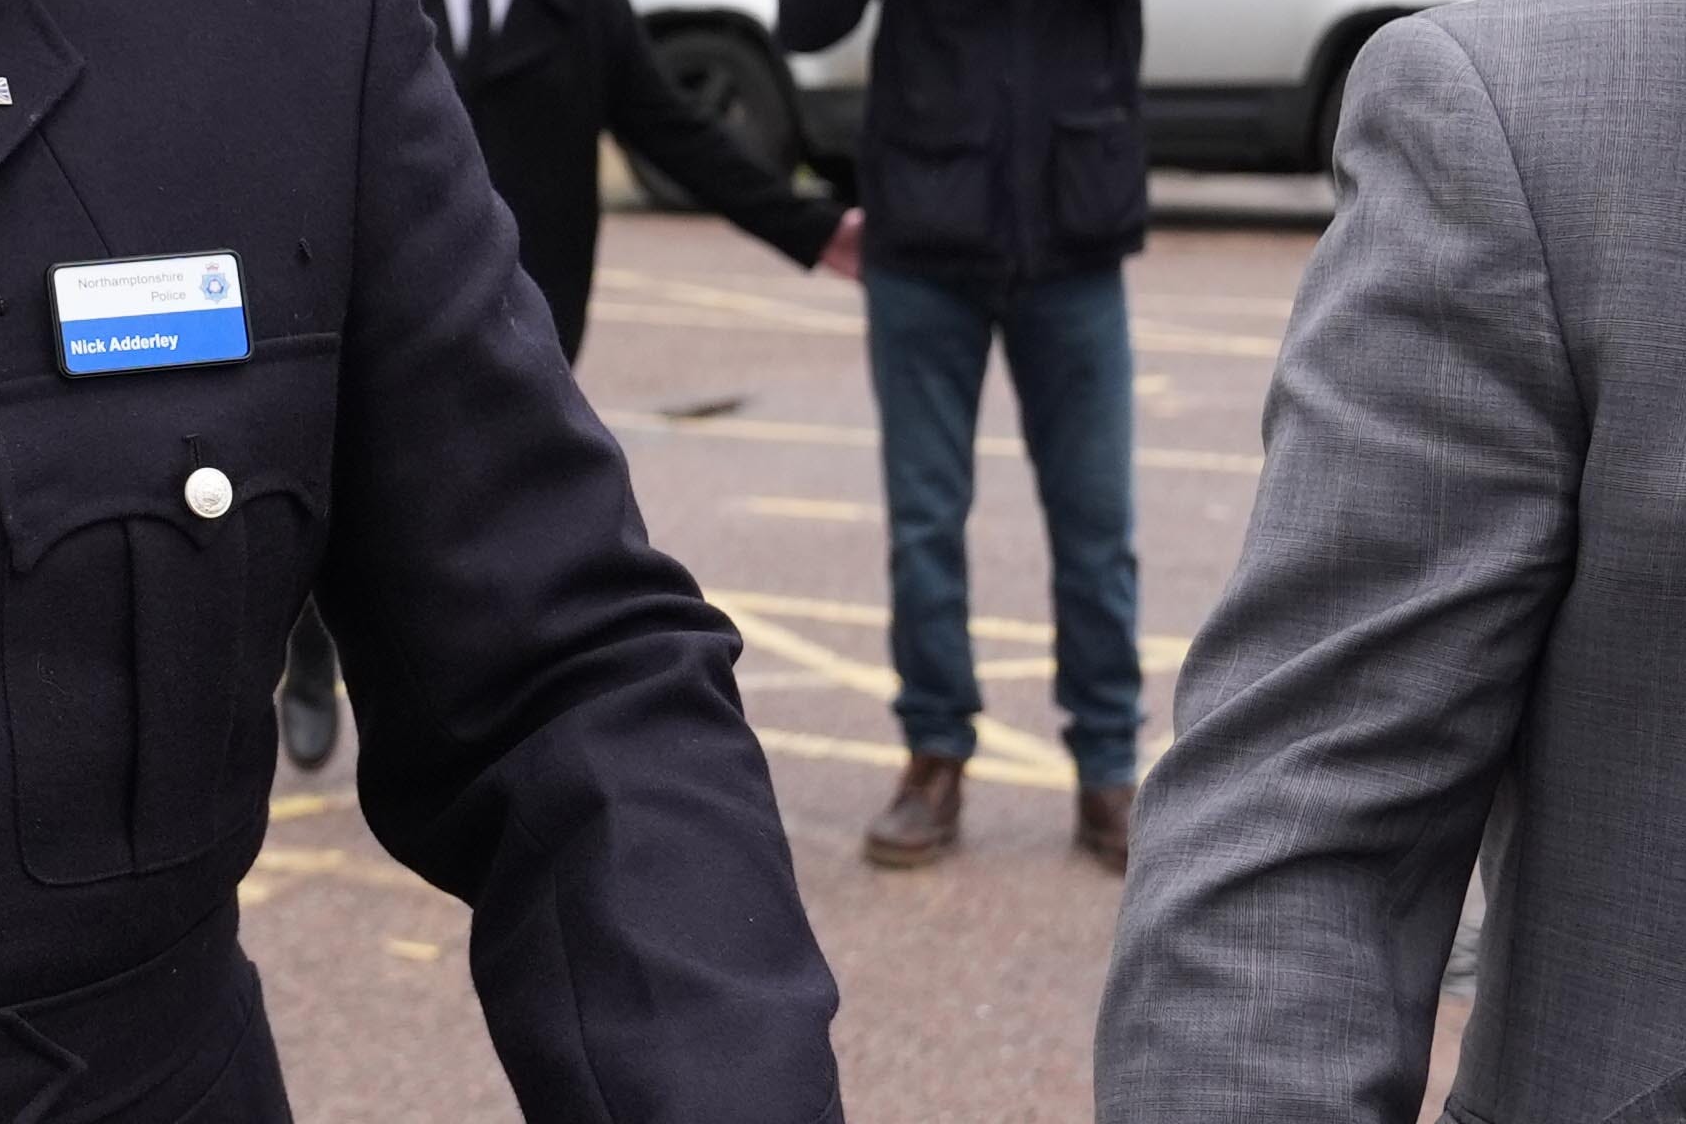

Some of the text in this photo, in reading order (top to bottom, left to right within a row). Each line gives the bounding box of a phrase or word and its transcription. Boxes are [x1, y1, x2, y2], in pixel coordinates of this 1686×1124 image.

[77, 272, 185, 290] Northamptonshire
[150, 289, 187, 303] Police
[70, 333, 179, 356] Nick Adderley
